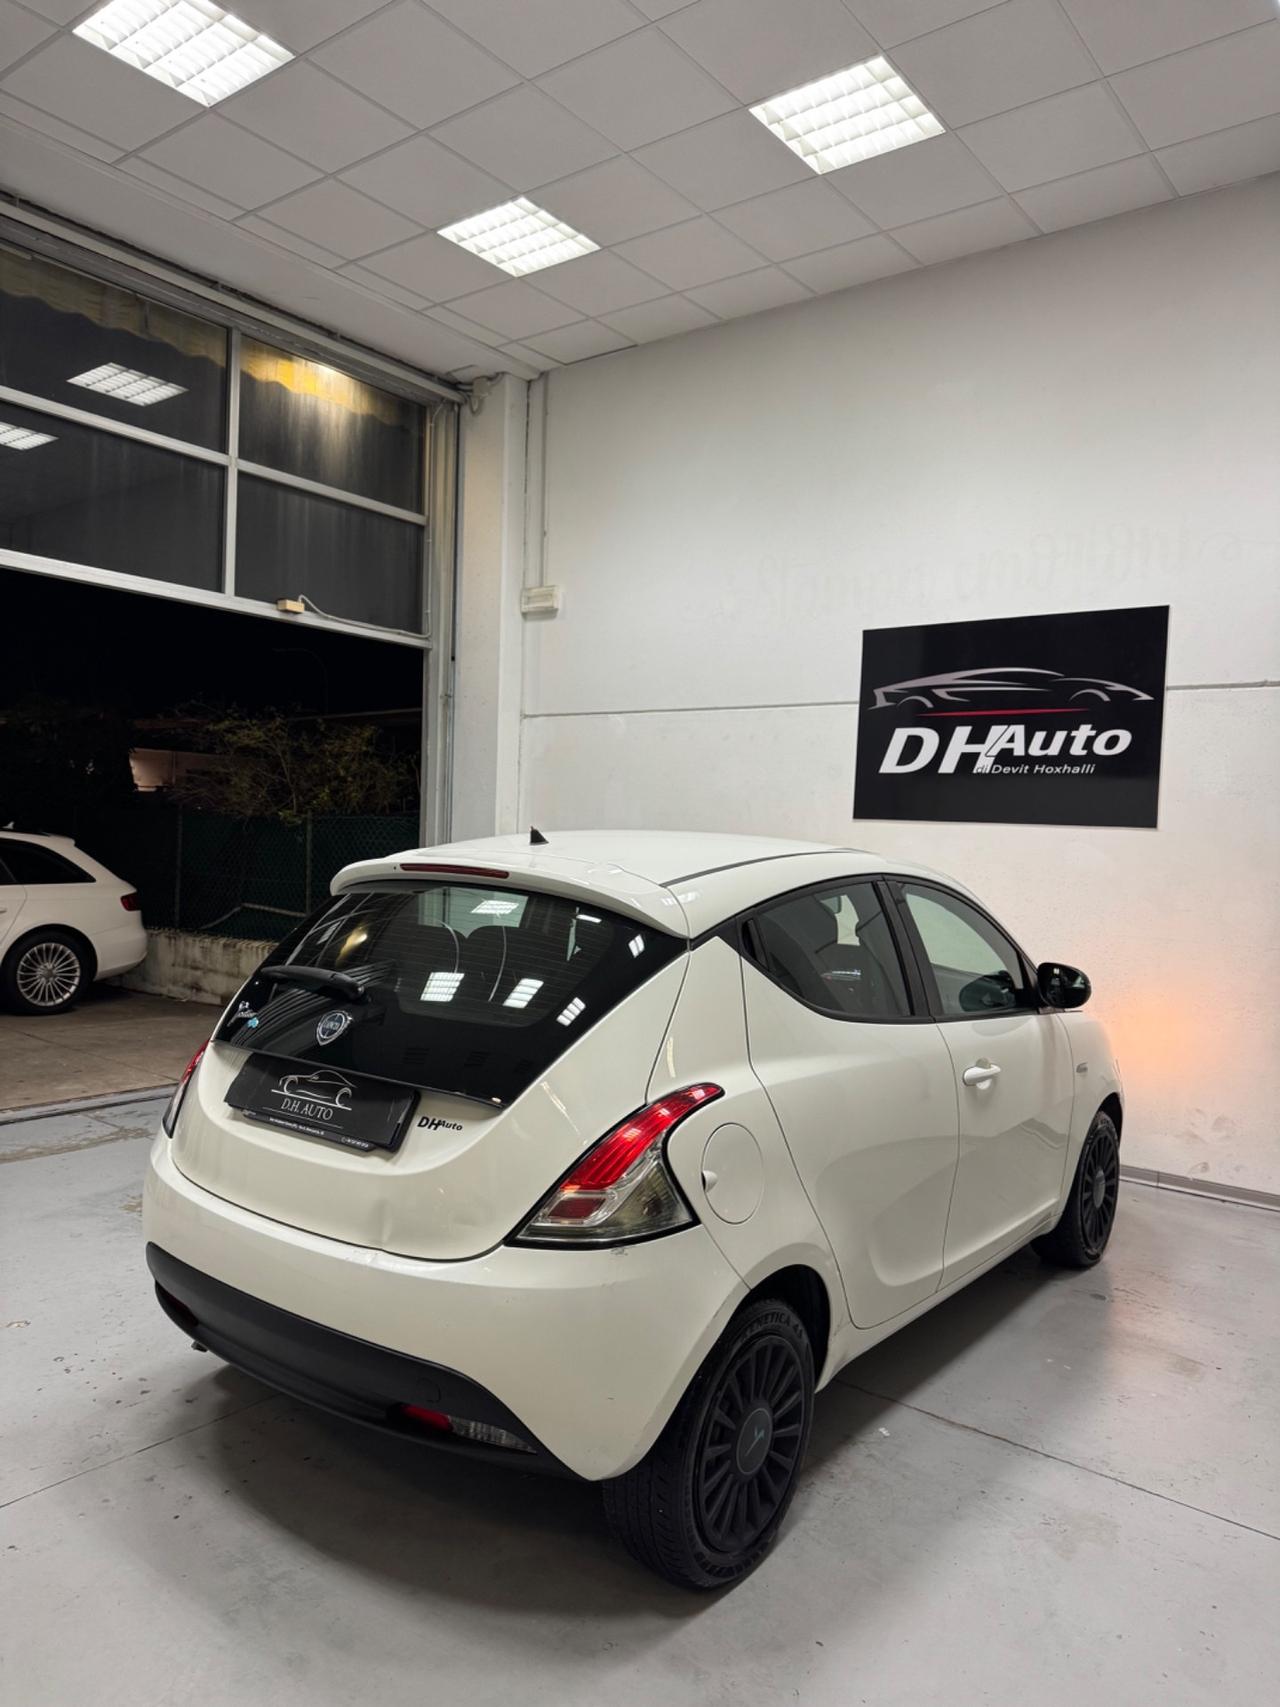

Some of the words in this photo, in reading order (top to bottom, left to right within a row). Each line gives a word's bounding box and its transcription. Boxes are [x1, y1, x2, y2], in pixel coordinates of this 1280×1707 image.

[991, 764, 1029, 774] Devit
[1033, 764, 1096, 774] Hoxhalli
[281, 1098, 300, 1112] D.H.
[300, 1104, 334, 1120] AUTO
